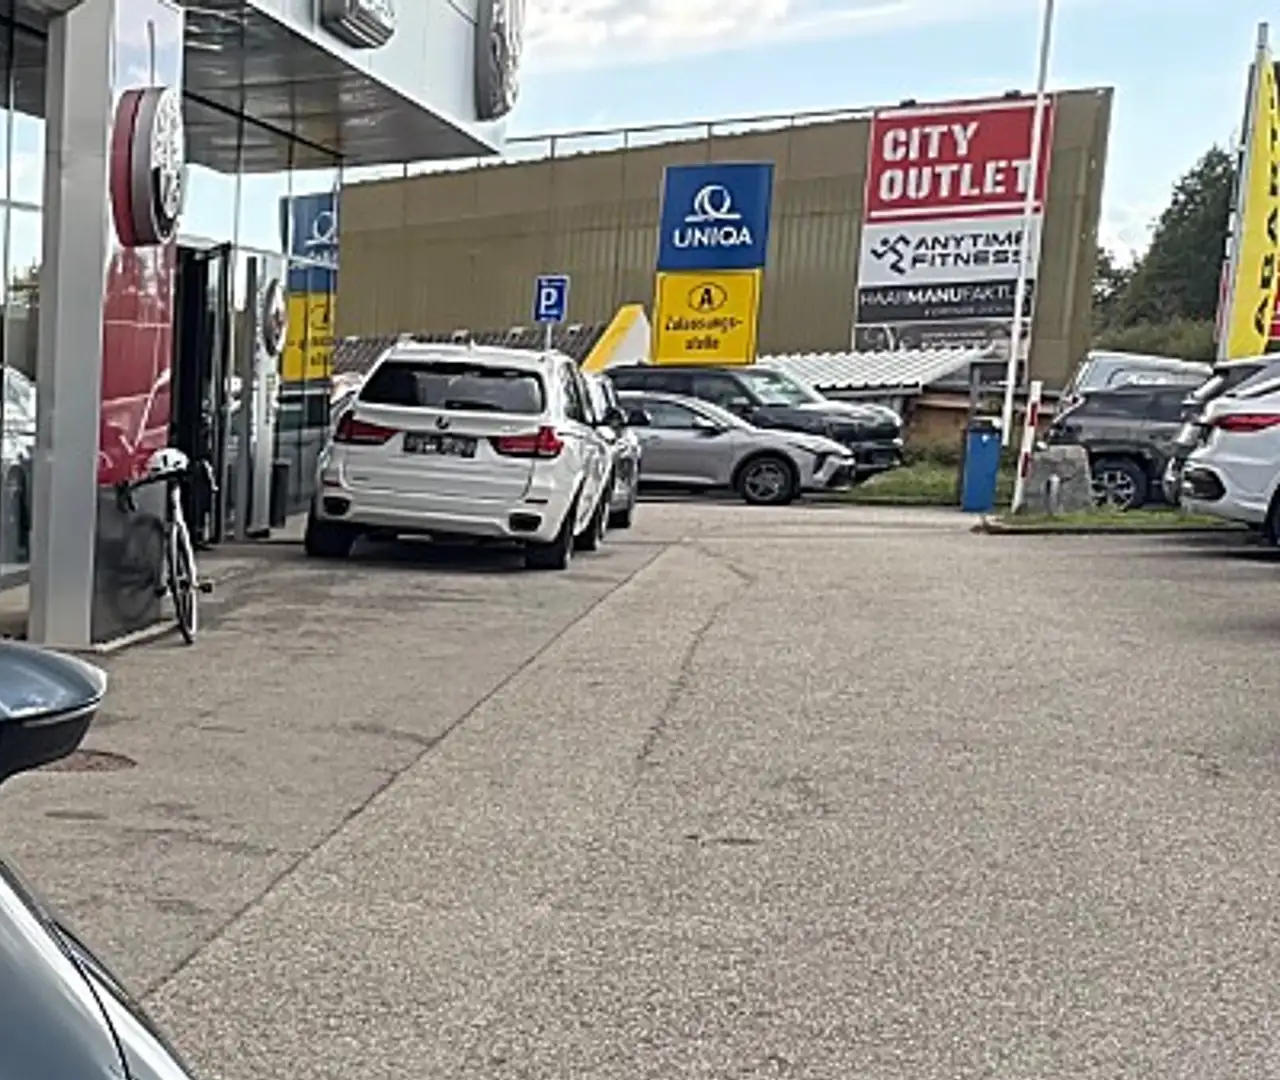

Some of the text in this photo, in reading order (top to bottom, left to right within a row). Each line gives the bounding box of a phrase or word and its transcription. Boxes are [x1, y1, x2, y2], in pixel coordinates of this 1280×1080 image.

[882, 121, 980, 162] CITY
[878, 158, 1032, 202] OUTLET
[672, 226, 753, 248] UNIQA
[540, 287, 559, 314] P
[699, 287, 716, 309] A
